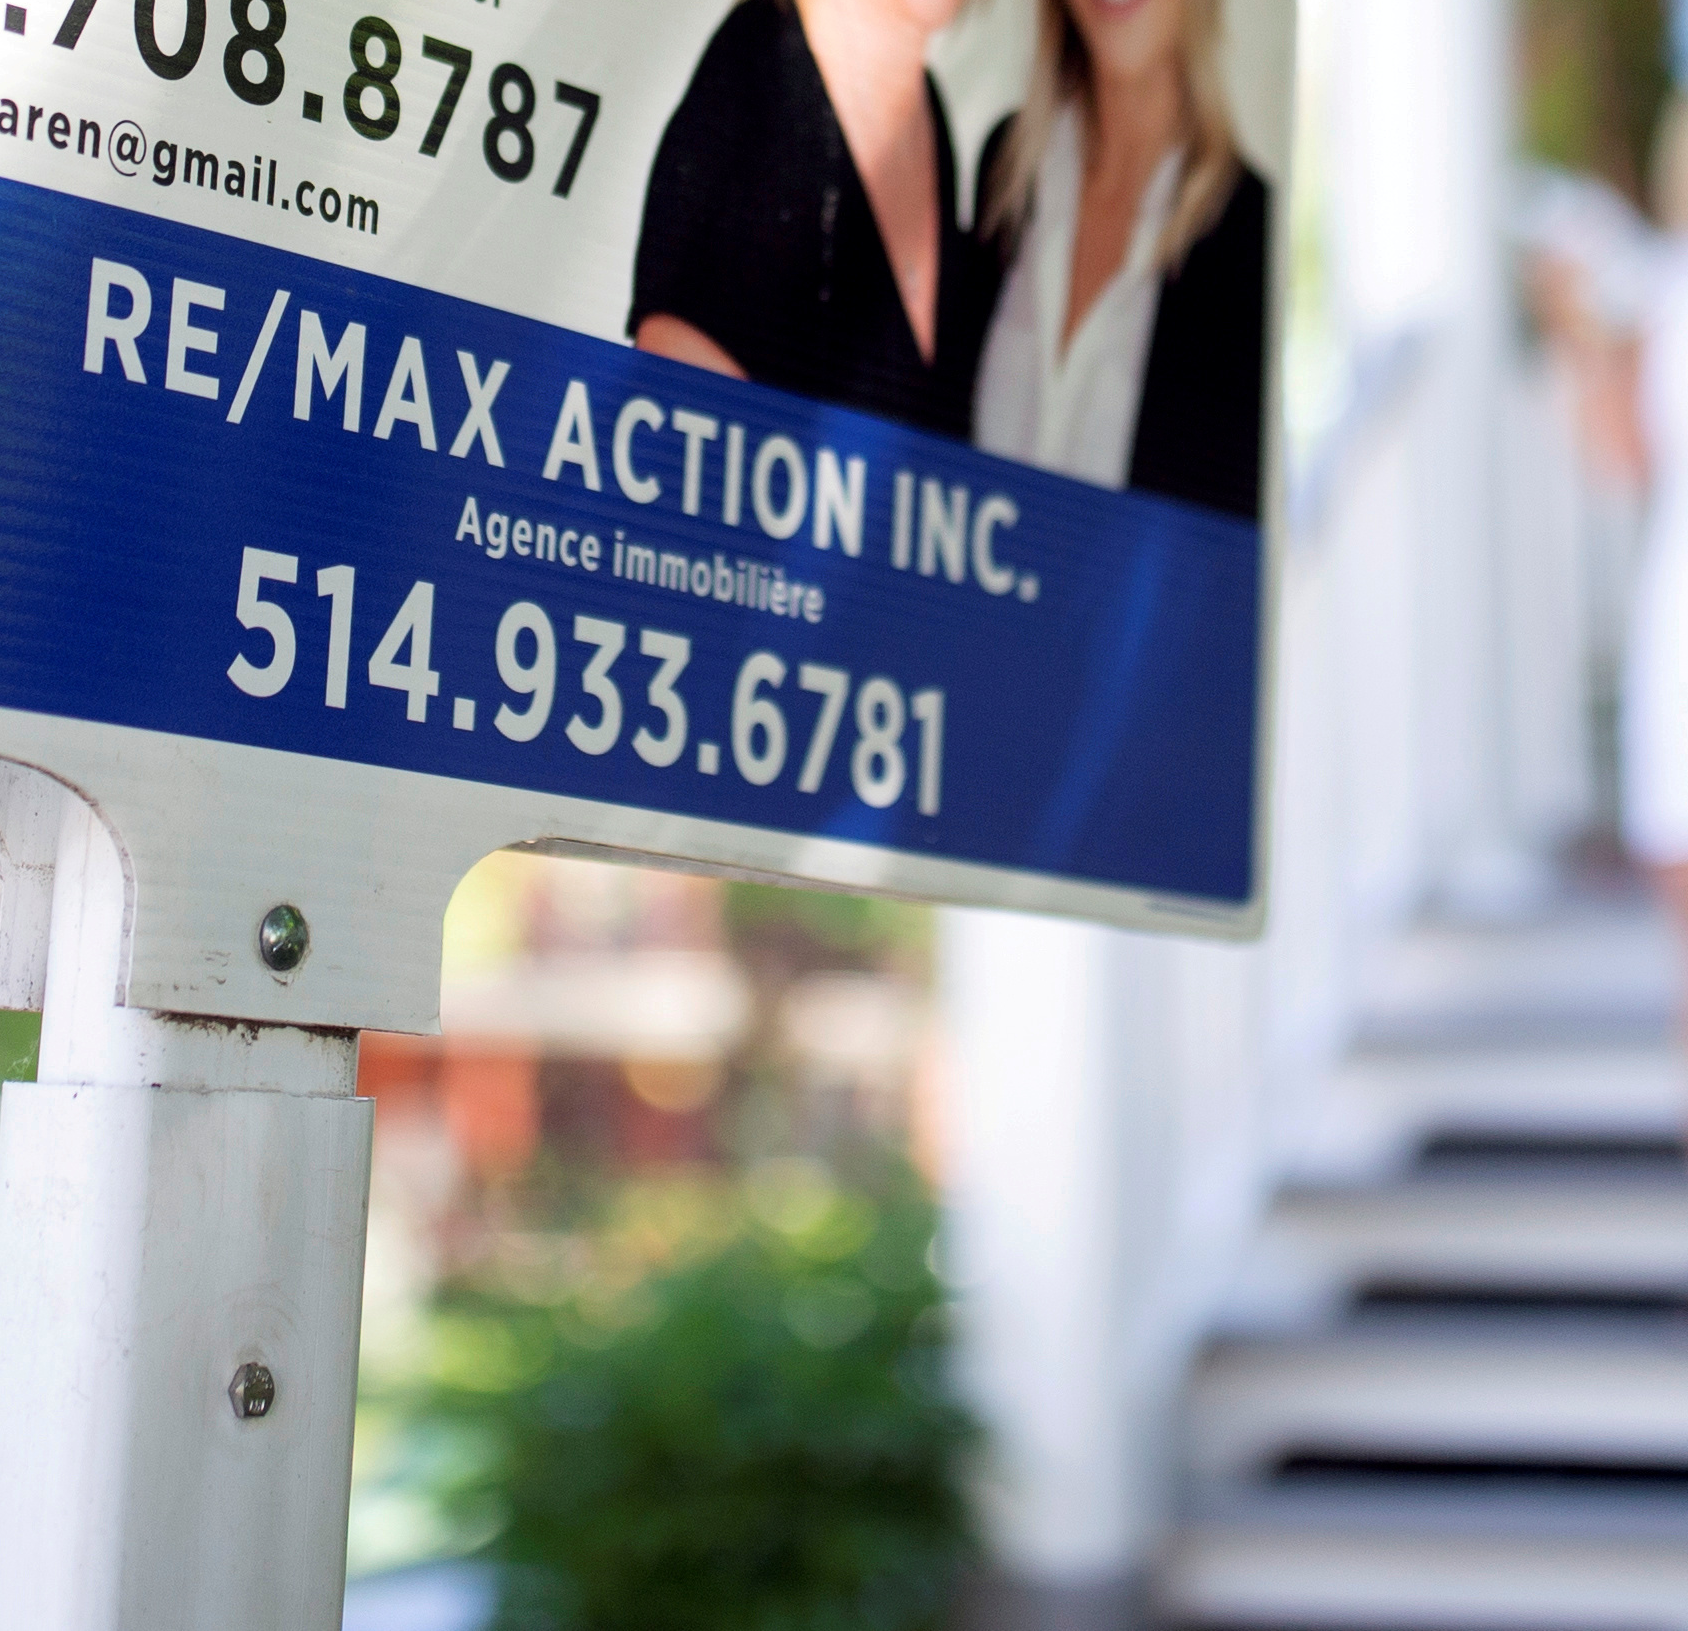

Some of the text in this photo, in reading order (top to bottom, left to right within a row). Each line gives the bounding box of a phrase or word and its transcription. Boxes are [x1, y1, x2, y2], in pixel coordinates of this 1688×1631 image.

[83, 258, 1039, 602] RE/MAX ACTION INC.
[456, 496, 824, 624] Agence immobilière
[226, 546, 944, 818] 514.933.6781
